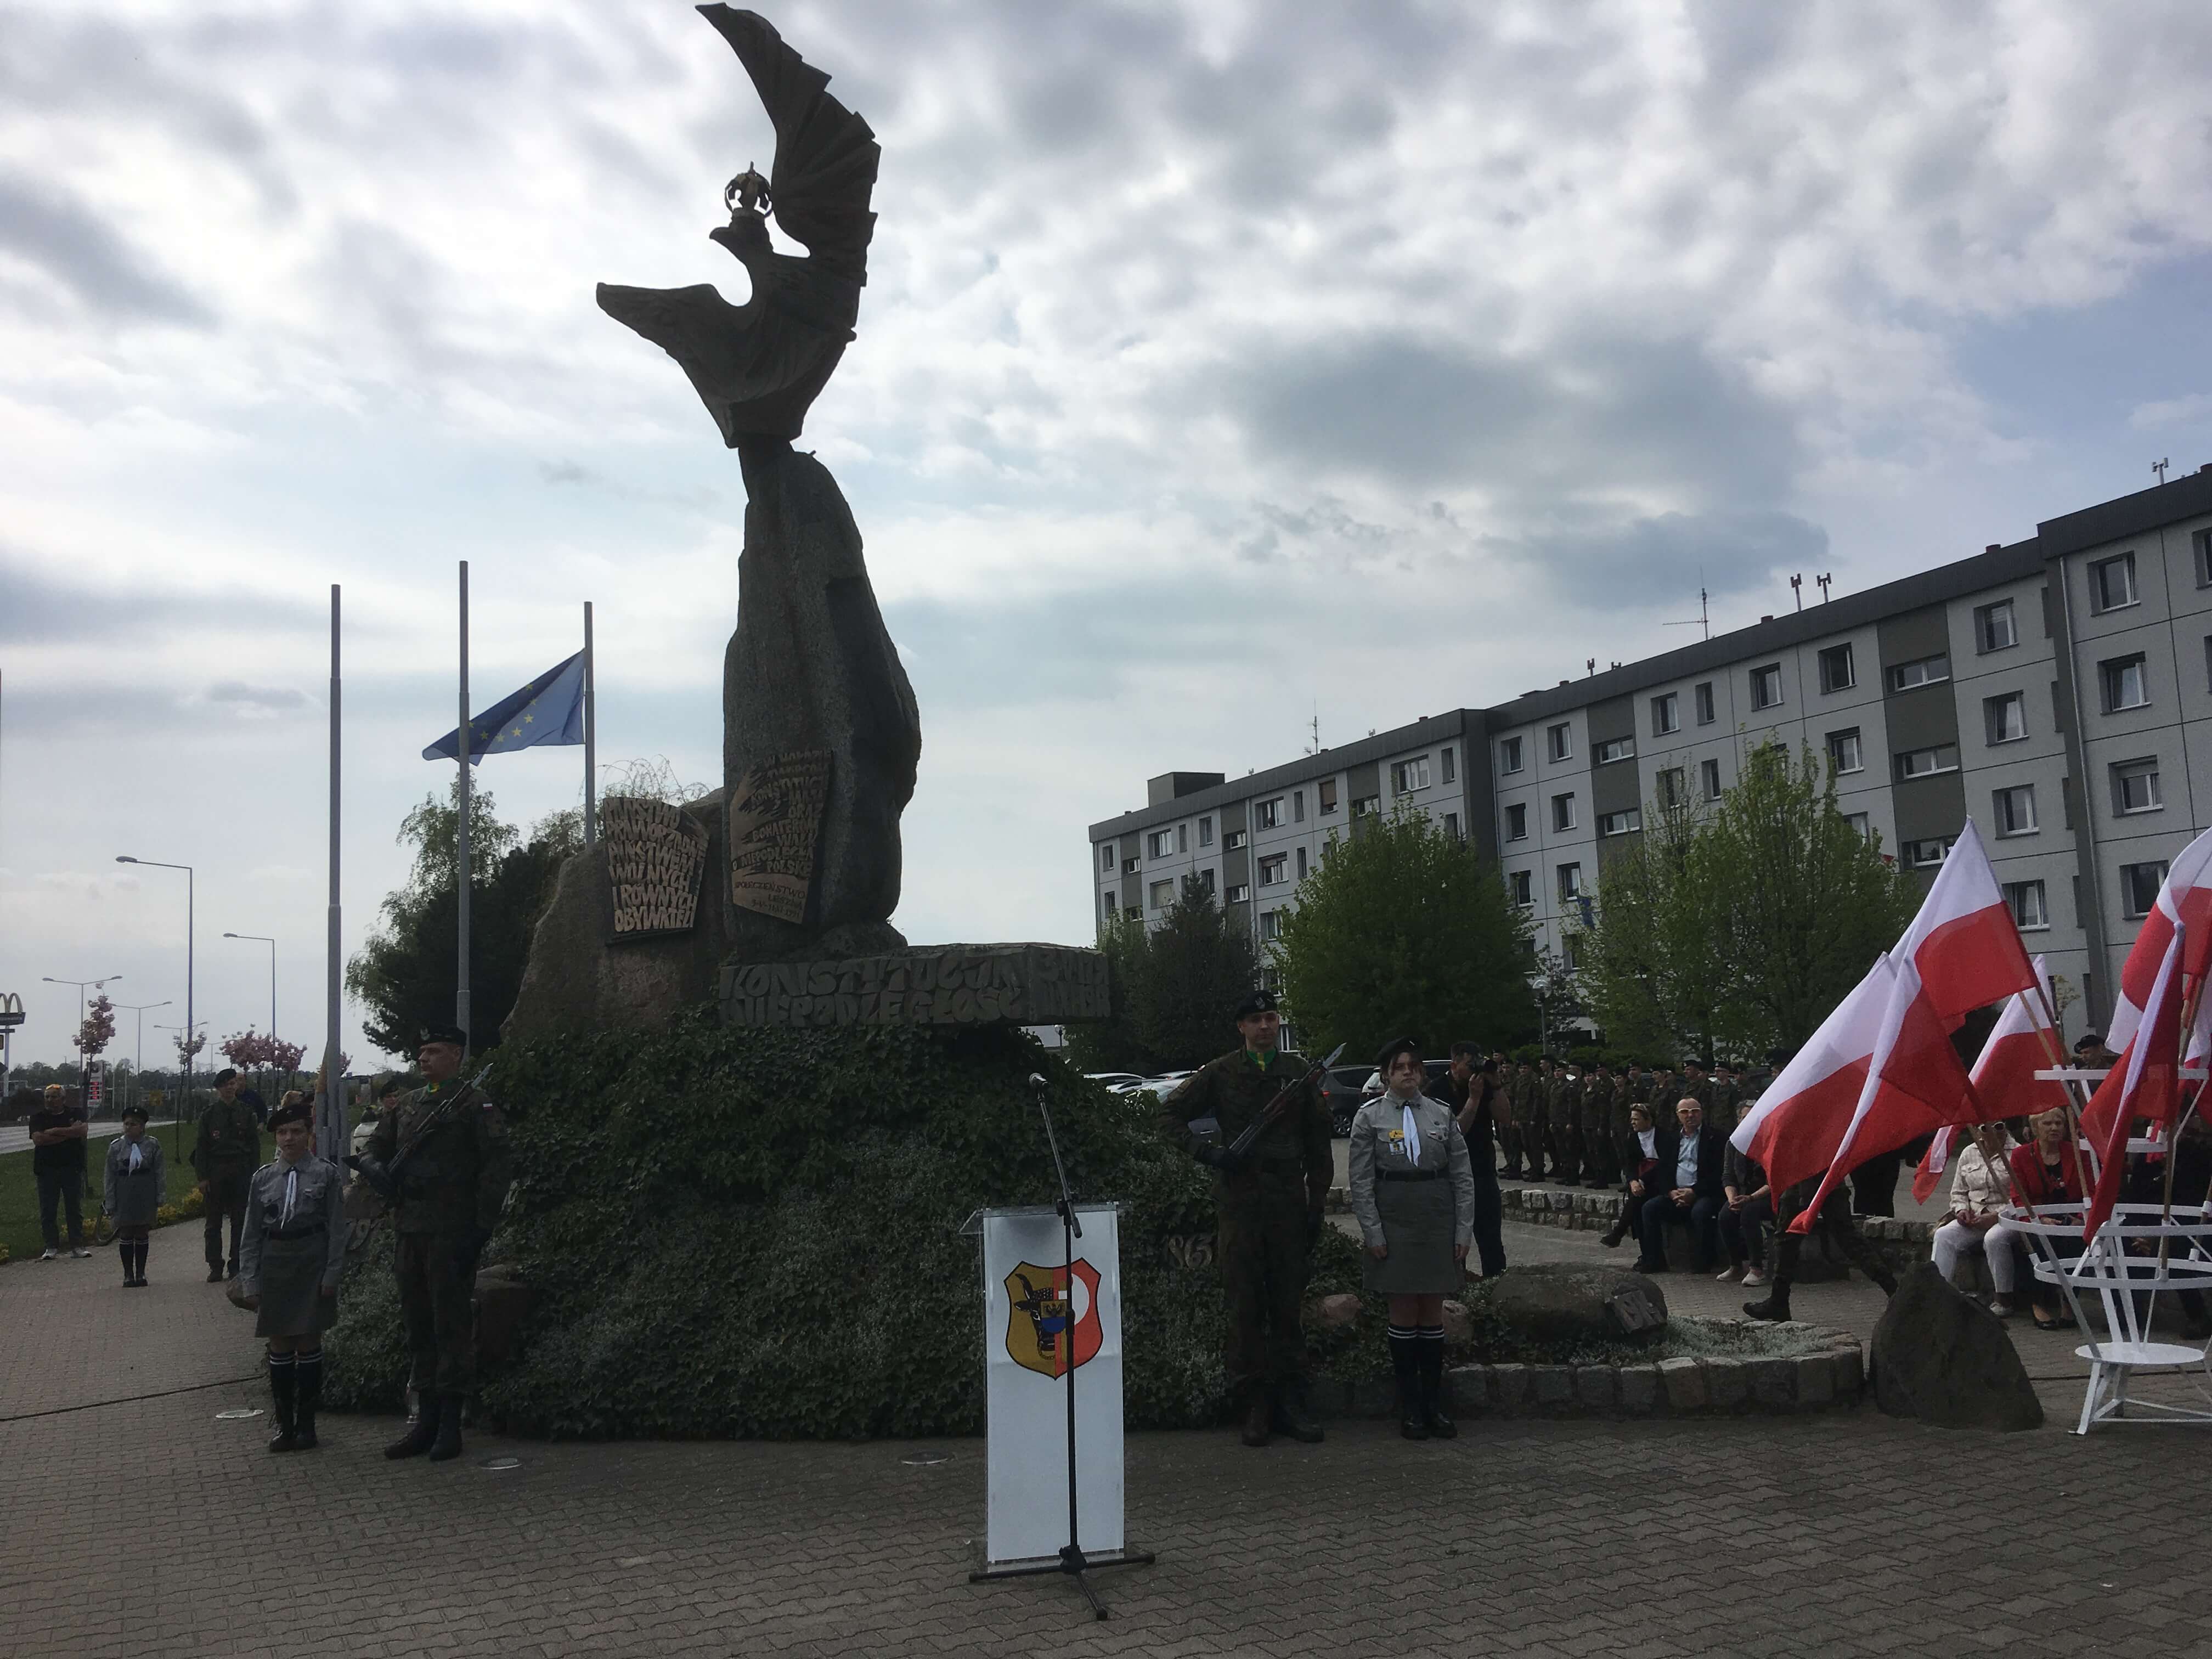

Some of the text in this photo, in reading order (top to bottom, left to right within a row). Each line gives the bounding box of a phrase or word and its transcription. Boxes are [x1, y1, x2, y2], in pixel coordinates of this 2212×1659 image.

[788, 802, 824, 819] ORAZ
[776, 832, 817, 848] WALK
[732, 859, 737, 871] O
[608, 862, 690, 893] WOLNYCH
[612, 882, 698, 911] I RÓWNYCH
[614, 905, 694, 932] OBYWATELI
